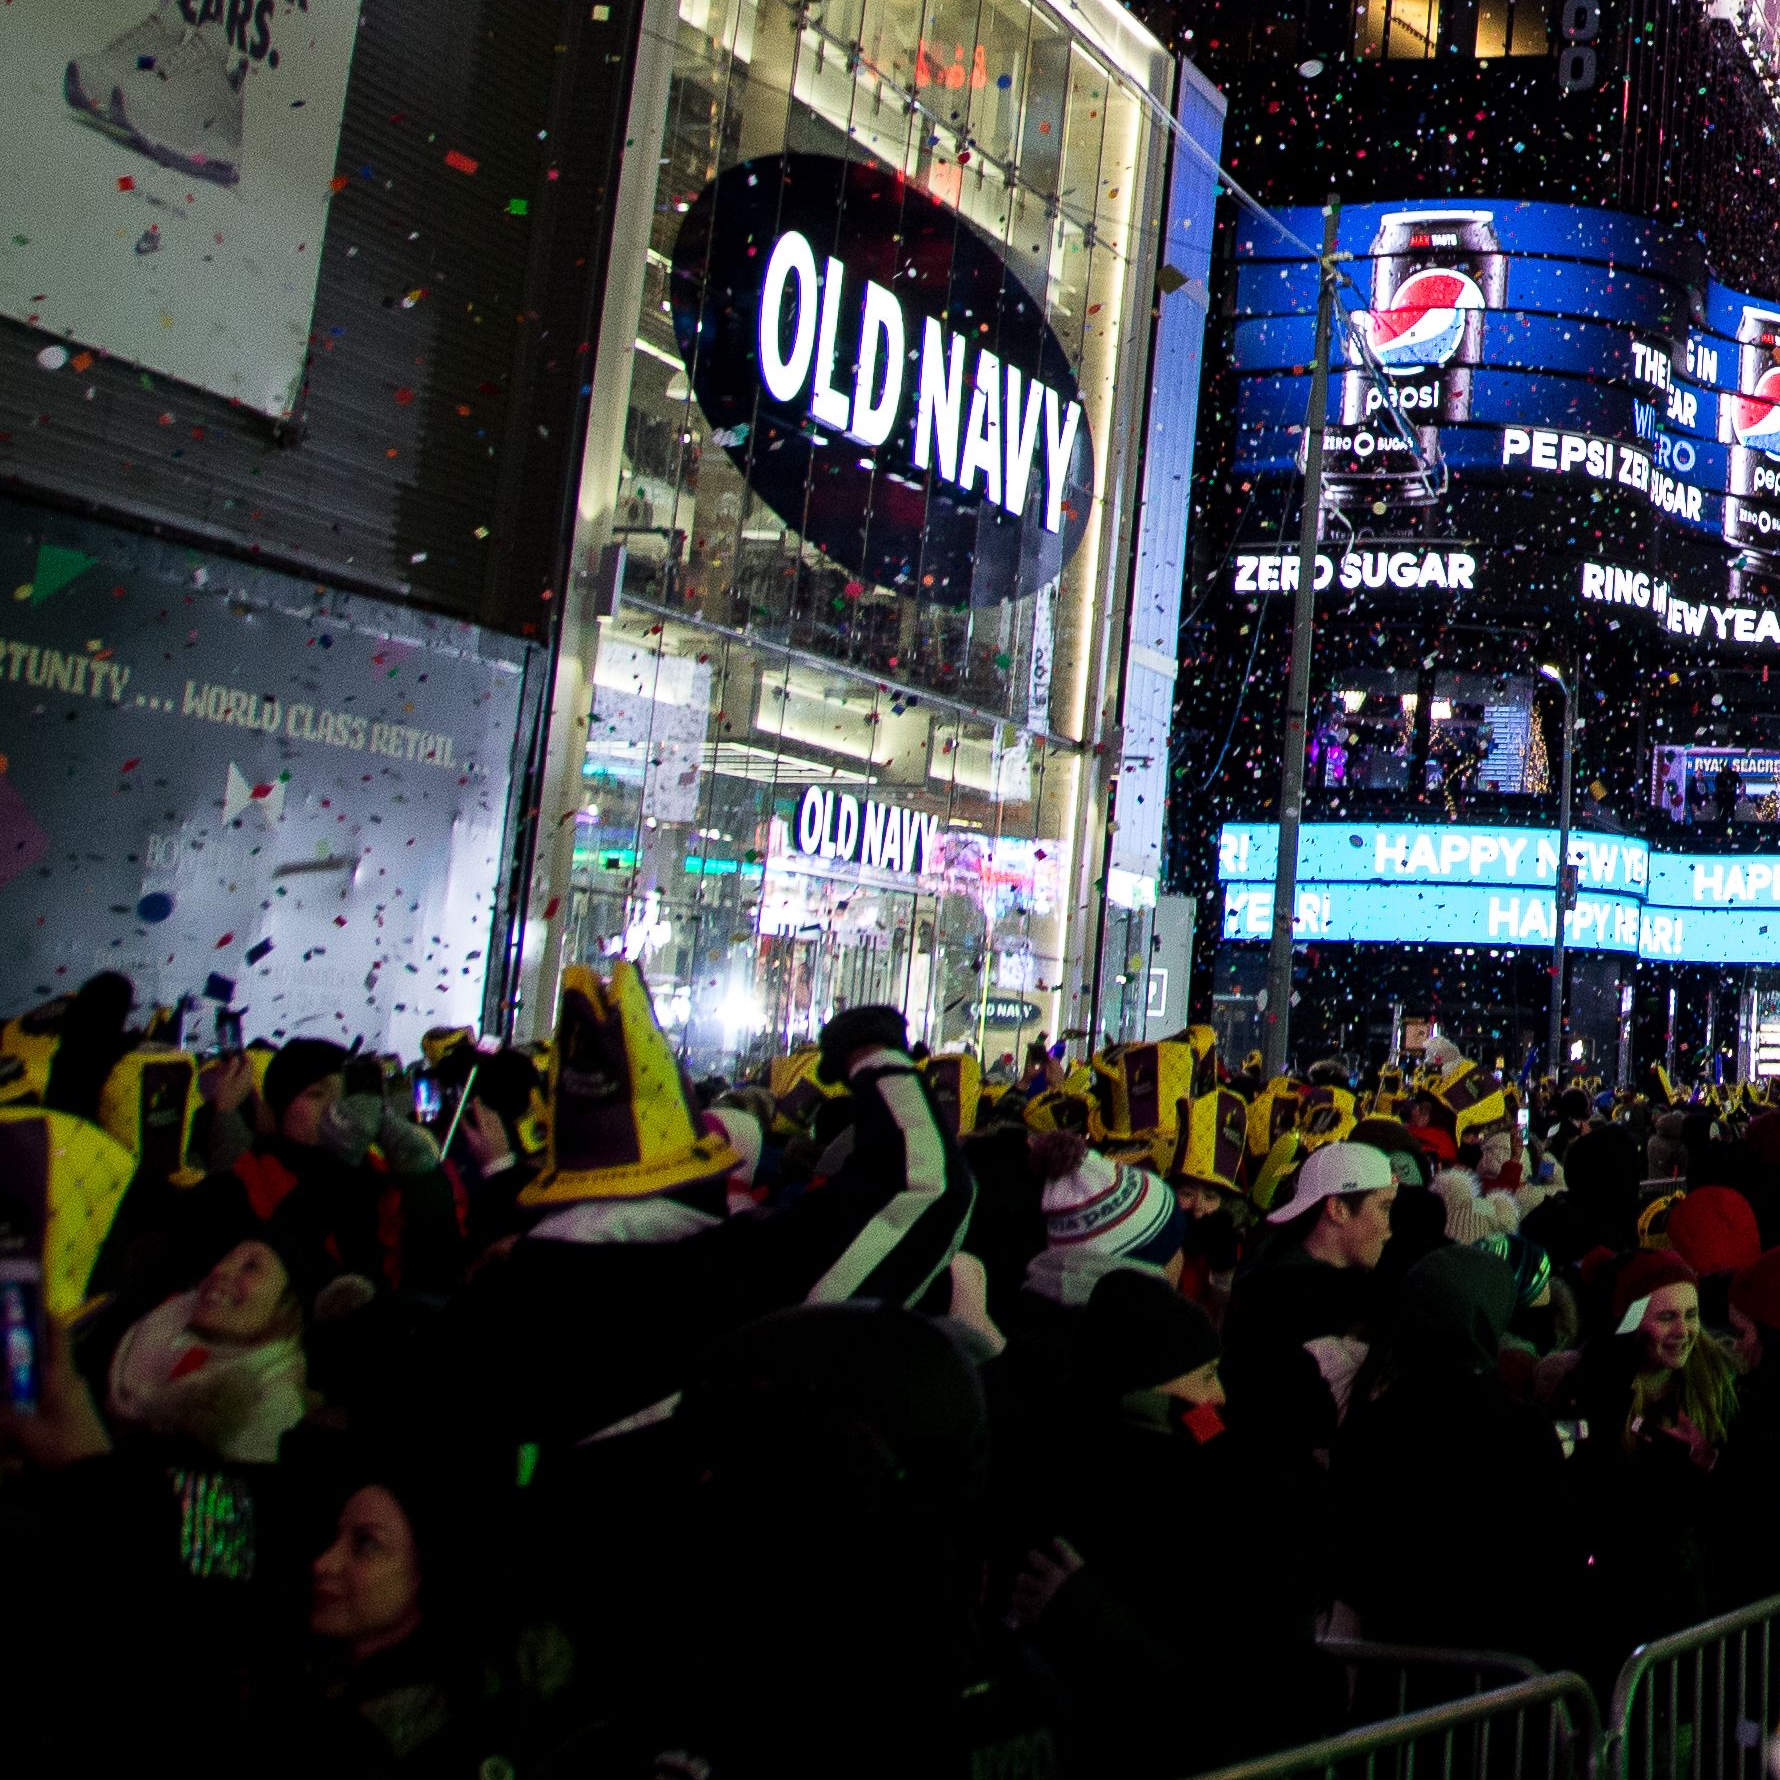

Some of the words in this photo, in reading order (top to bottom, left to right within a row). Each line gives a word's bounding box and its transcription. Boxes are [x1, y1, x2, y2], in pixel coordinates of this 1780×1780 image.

[758, 229, 905, 448] OLD
[911, 315, 1082, 535] NAVY
[1503, 426, 1613, 480] PEPSI
[1235, 555, 1334, 592] ZERO
[1339, 551, 1476, 591] SUGAR
[1582, 562, 1651, 609] RING
[182, 681, 282, 733] WORLD
[286, 702, 366, 751] CLASS
[800, 784, 859, 862] OLD
[861, 800, 939, 875] NAVY
[1376, 833, 1528, 877] HAPPY
[1535, 838, 1616, 884] NEW
[1488, 897, 1614, 942] HAPPY
